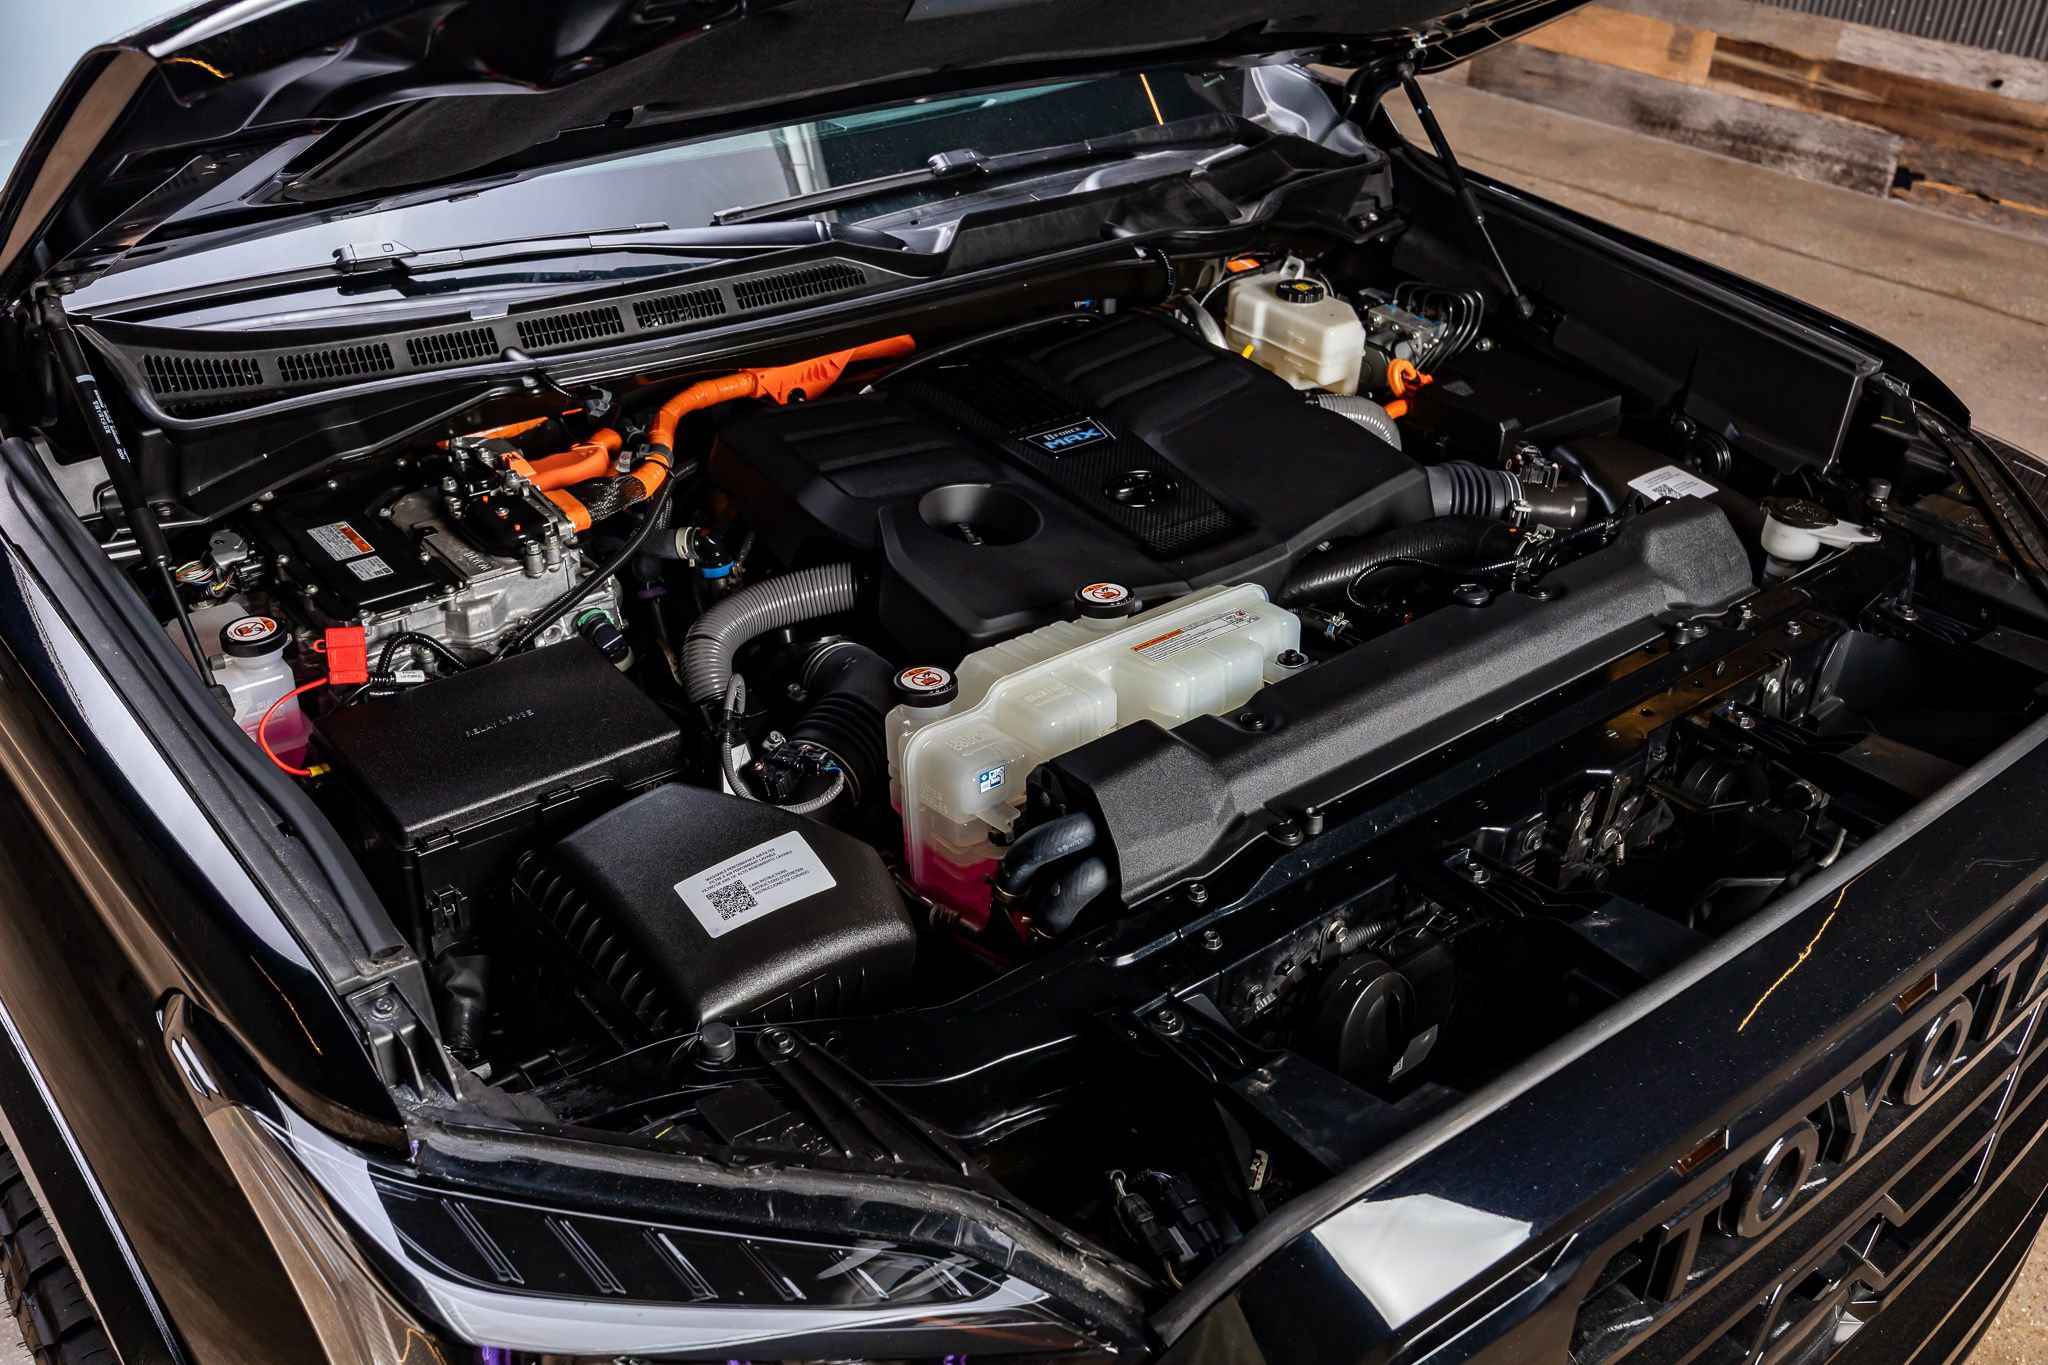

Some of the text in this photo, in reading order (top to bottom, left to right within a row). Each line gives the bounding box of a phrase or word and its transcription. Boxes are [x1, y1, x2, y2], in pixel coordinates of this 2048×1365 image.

[1043, 428, 1102, 449] MAX
[507, 709, 534, 723] FUSE
[775, 850, 792, 859] LAVABLE
[704, 870, 727, 881] WASHABLE
[726, 856, 756, 871] PERFORMANCE
[732, 860, 759, 873] PERFORMANT
[758, 852, 776, 862] LAVABLE
[759, 868, 788, 883] INSTRUCTIONS
[751, 877, 780, 892] INSTRUCTIONS
